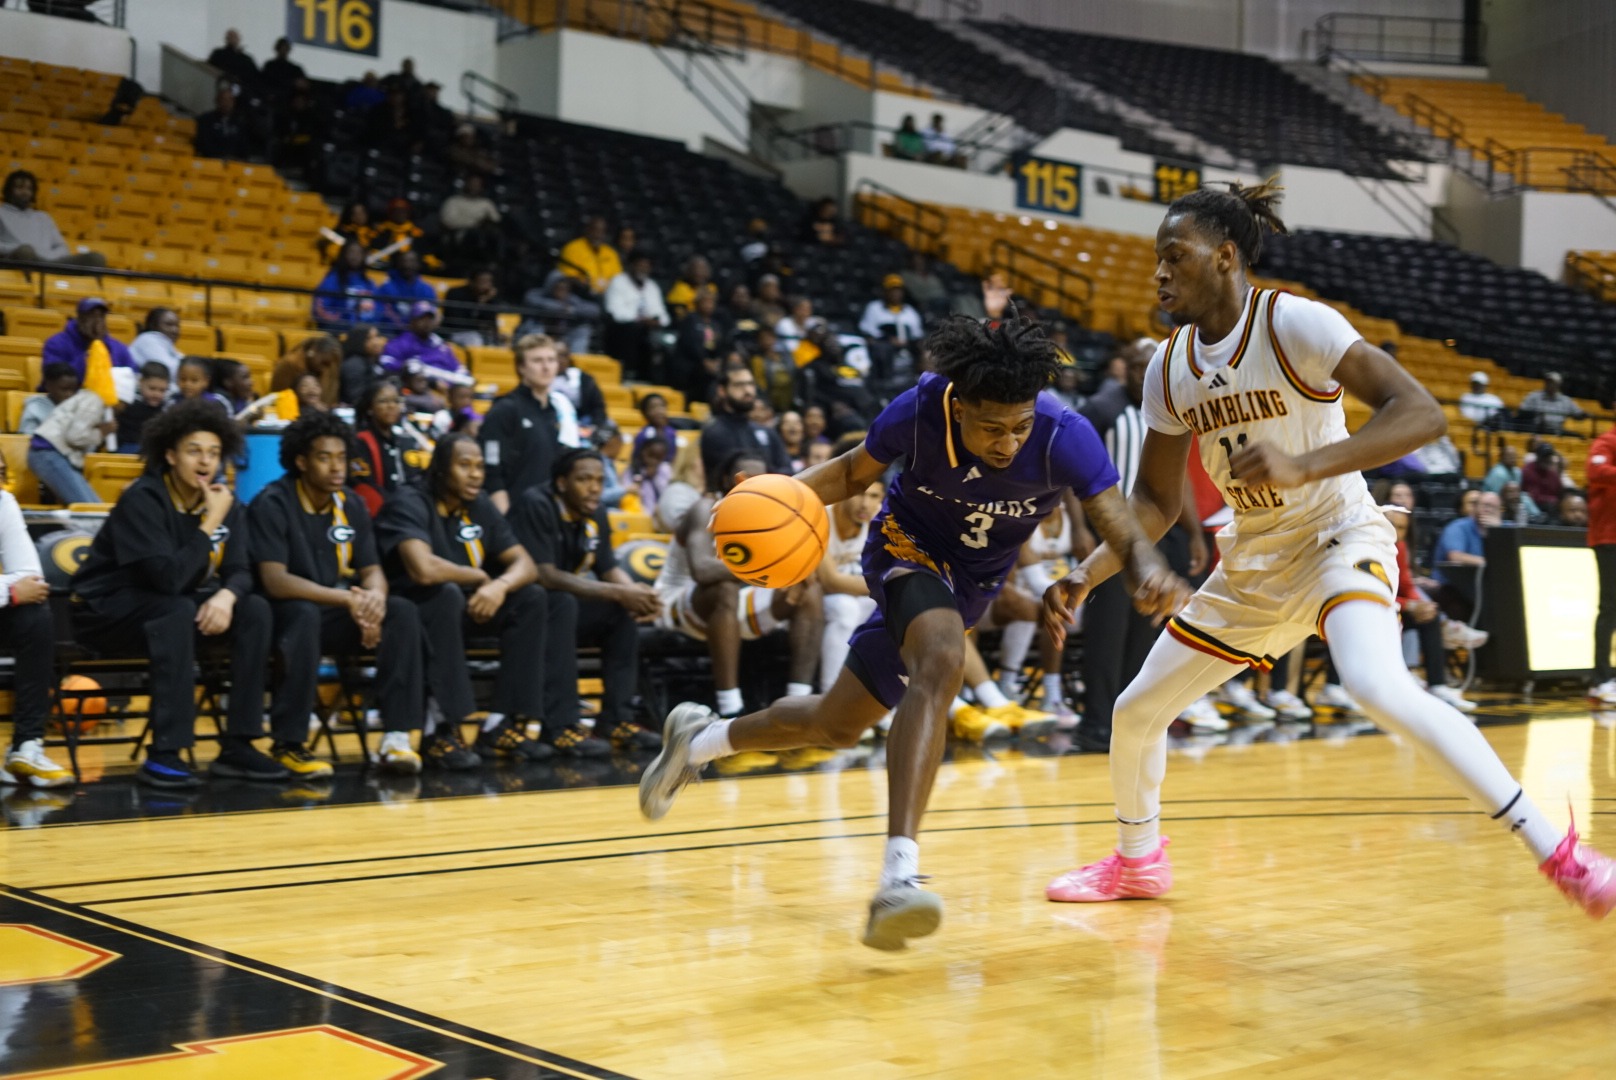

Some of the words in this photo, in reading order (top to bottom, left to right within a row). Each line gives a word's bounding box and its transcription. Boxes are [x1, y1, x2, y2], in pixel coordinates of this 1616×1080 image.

[294, 0, 373, 50] 116
[1021, 160, 1078, 212] 115
[1182, 390, 1288, 436] GRAMBLING
[1219, 433, 1248, 480] 1
[1226, 484, 1284, 510] STATE
[960, 511, 995, 549] 3
